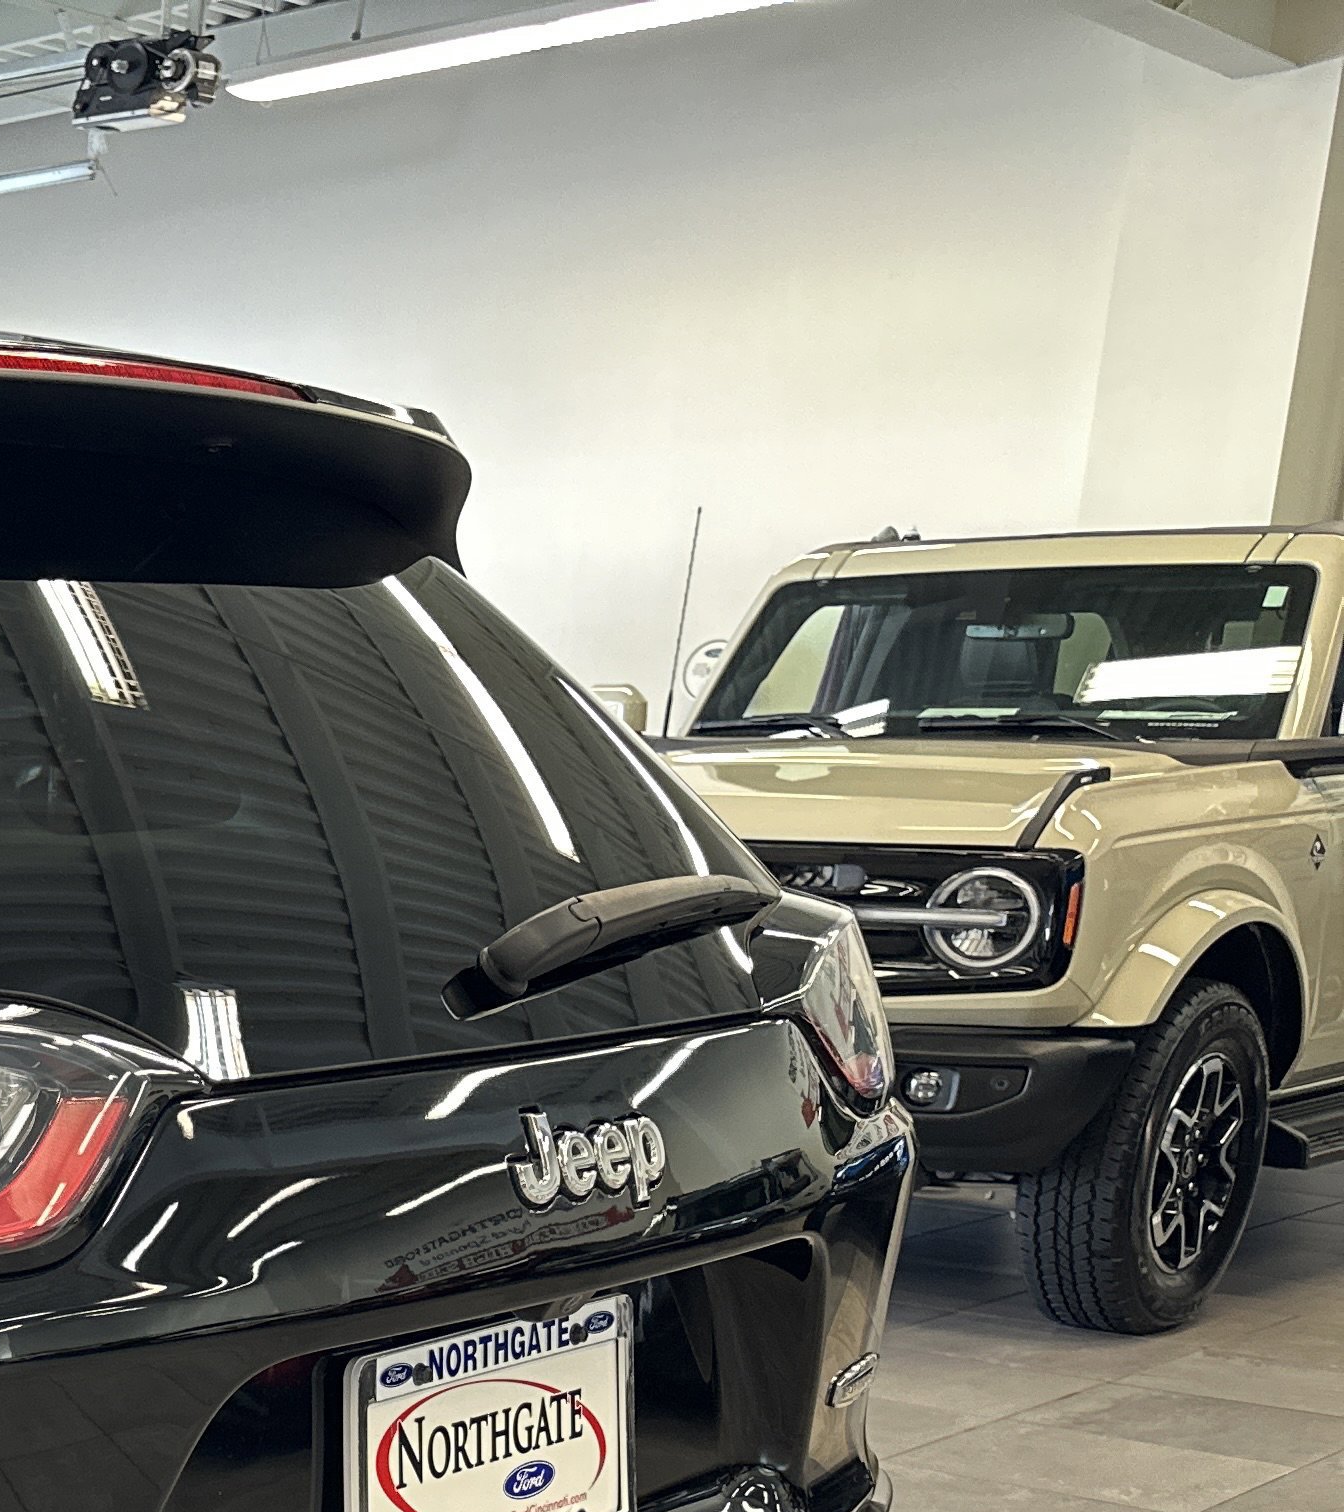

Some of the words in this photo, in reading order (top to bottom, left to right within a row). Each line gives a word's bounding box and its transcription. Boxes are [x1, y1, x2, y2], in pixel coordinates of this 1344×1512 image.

[507, 1106, 666, 1208] Jeep
[428, 1316, 570, 1382] NORTHGATE
[512, 1466, 546, 1494] Ford
